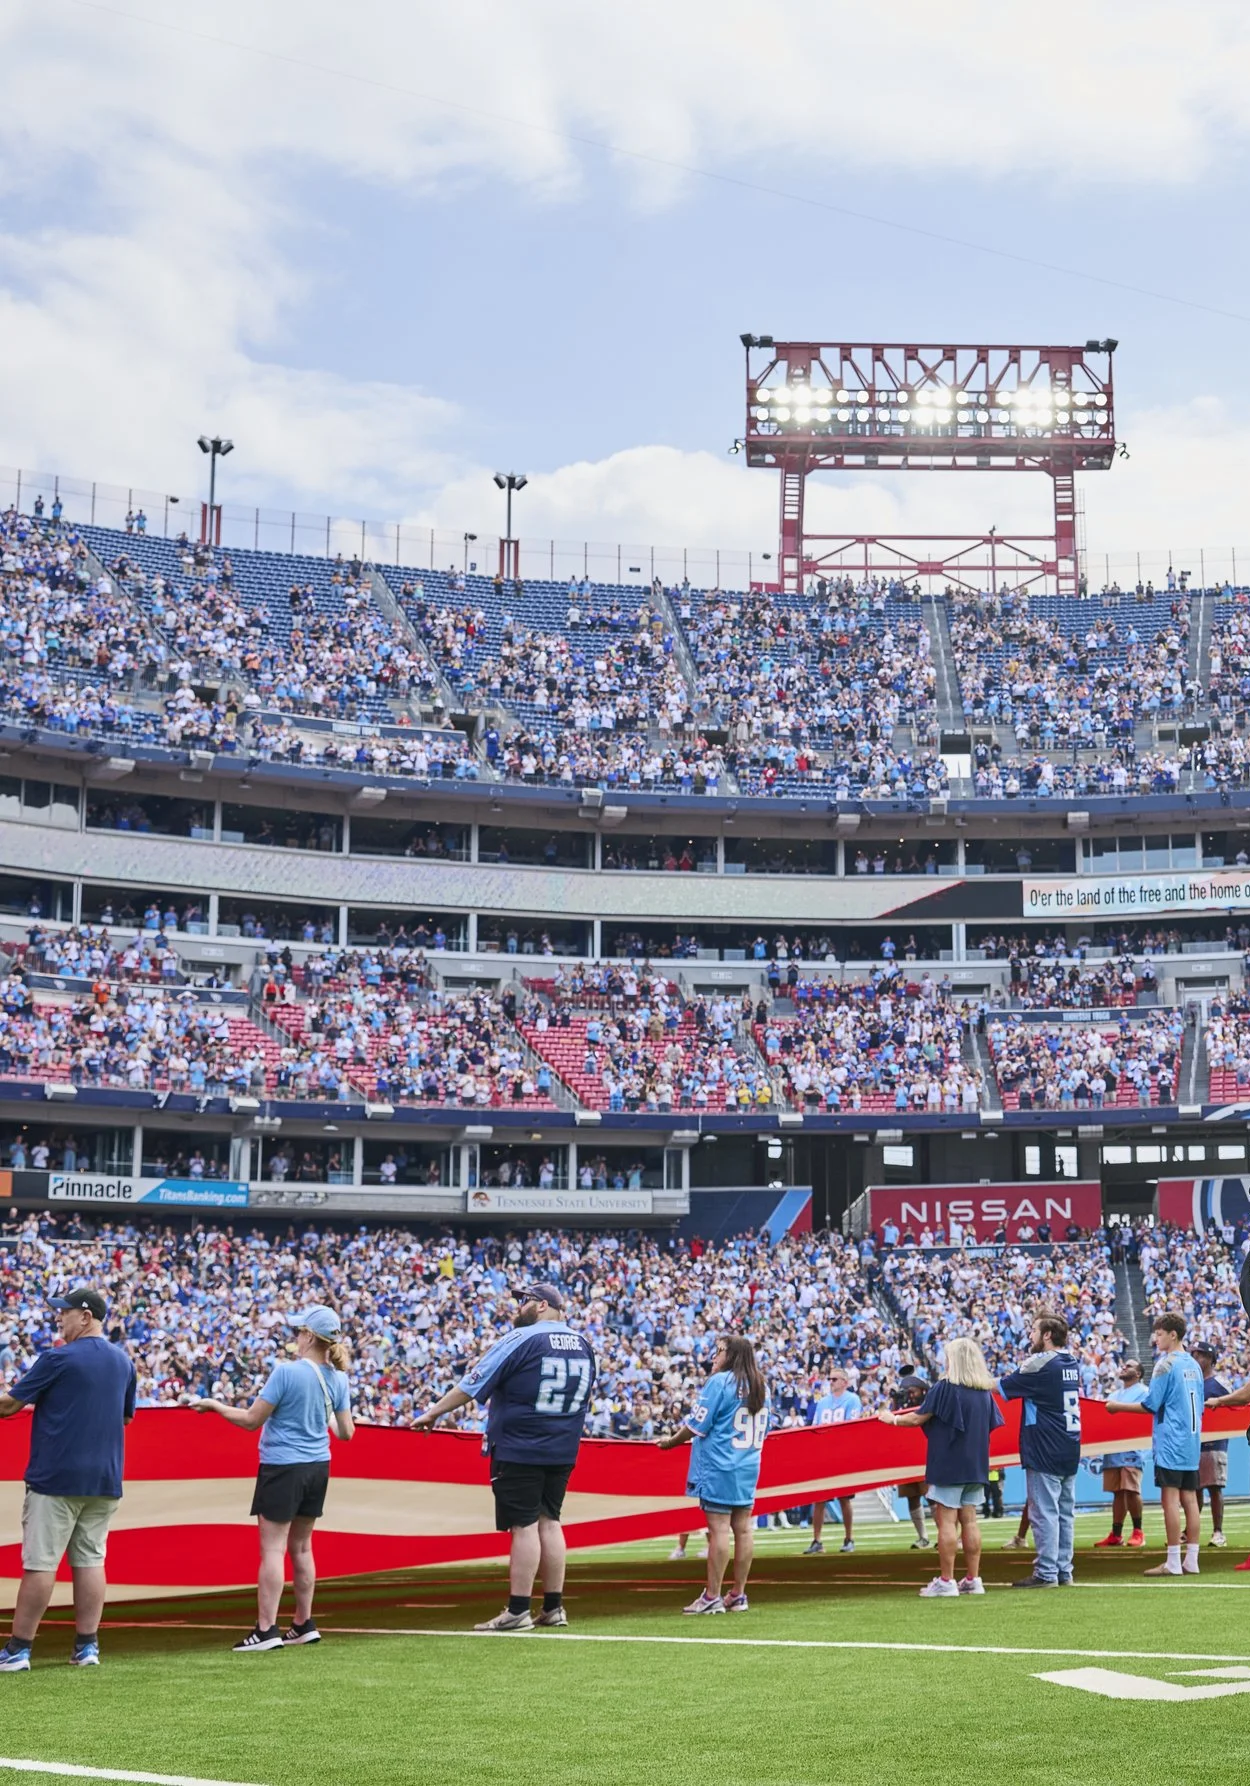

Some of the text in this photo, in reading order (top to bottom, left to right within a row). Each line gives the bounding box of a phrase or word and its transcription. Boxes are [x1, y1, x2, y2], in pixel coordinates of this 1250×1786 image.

[1030, 889, 1052, 906] O'er
[1056, 889, 1073, 905] the
[1077, 888, 1100, 905] land
[1104, 887, 1118, 904] of
[1118, 886, 1136, 903] the
[1140, 885, 1161, 902] free
[1165, 884, 1185, 901] and
[1189, 883, 1207, 899] the
[1210, 882, 1241, 899] home
[53, 1177, 132, 1199] Pinnacle
[159, 1188, 247, 1206] TitansBanking.com
[495, 1194, 649, 1209] TENNESSEE STATE UNIVERSITY
[901, 1198, 1072, 1223] NISSAN
[549, 1334, 582, 1350] GEORGE
[535, 1356, 590, 1413] 27
[1062, 1369, 1079, 1381] LEVIS
[1063, 1391, 1081, 1431] 8
[1190, 1391, 1197, 1434] 1
[732, 1407, 768, 1449] 98
